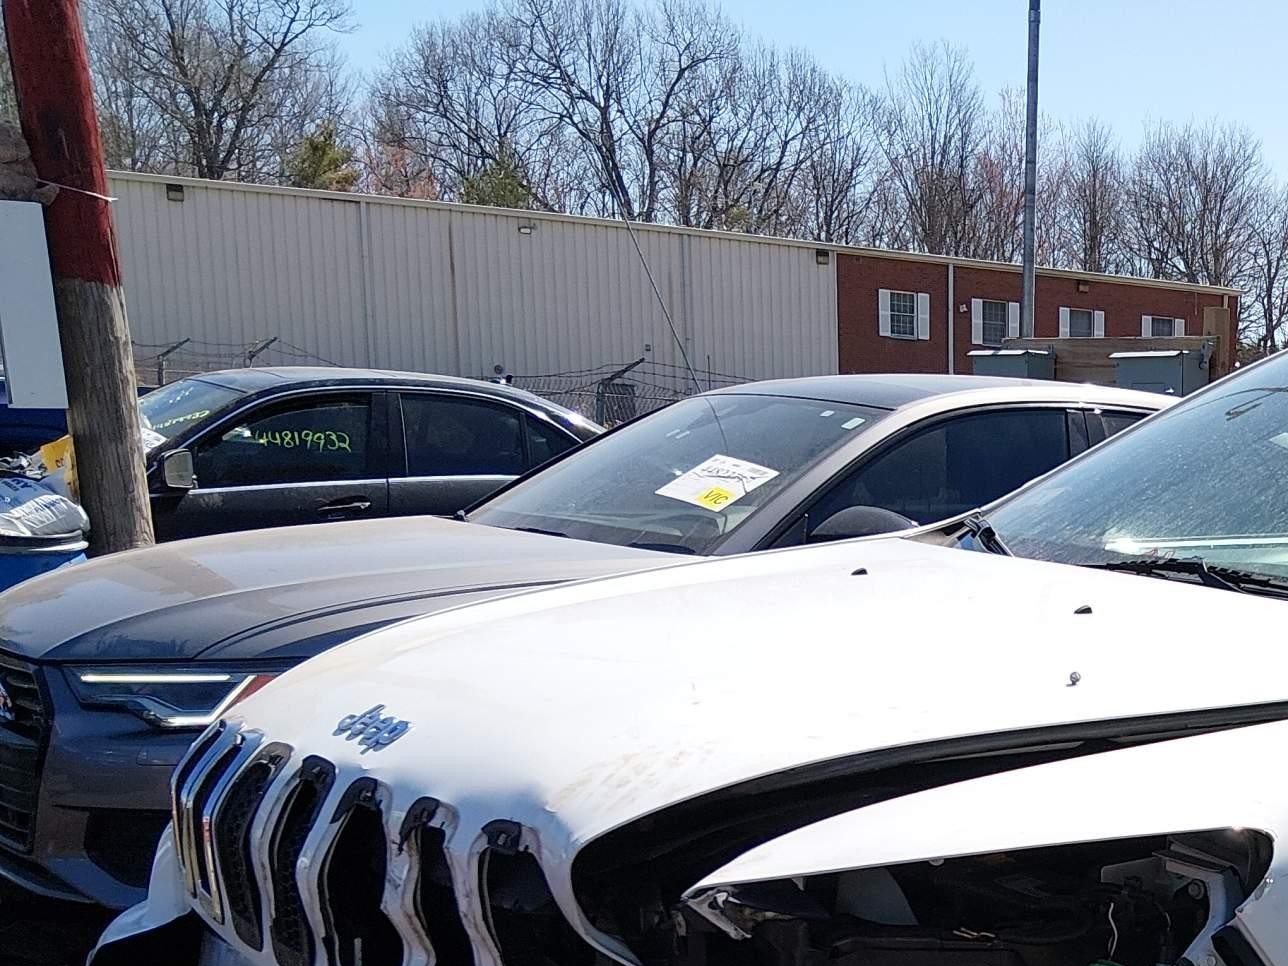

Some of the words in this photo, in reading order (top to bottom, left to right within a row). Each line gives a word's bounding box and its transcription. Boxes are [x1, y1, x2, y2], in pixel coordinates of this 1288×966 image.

[255, 429, 352, 453] 44819932
[703, 489, 729, 505] VIC
[332, 703, 411, 755] Jeep
